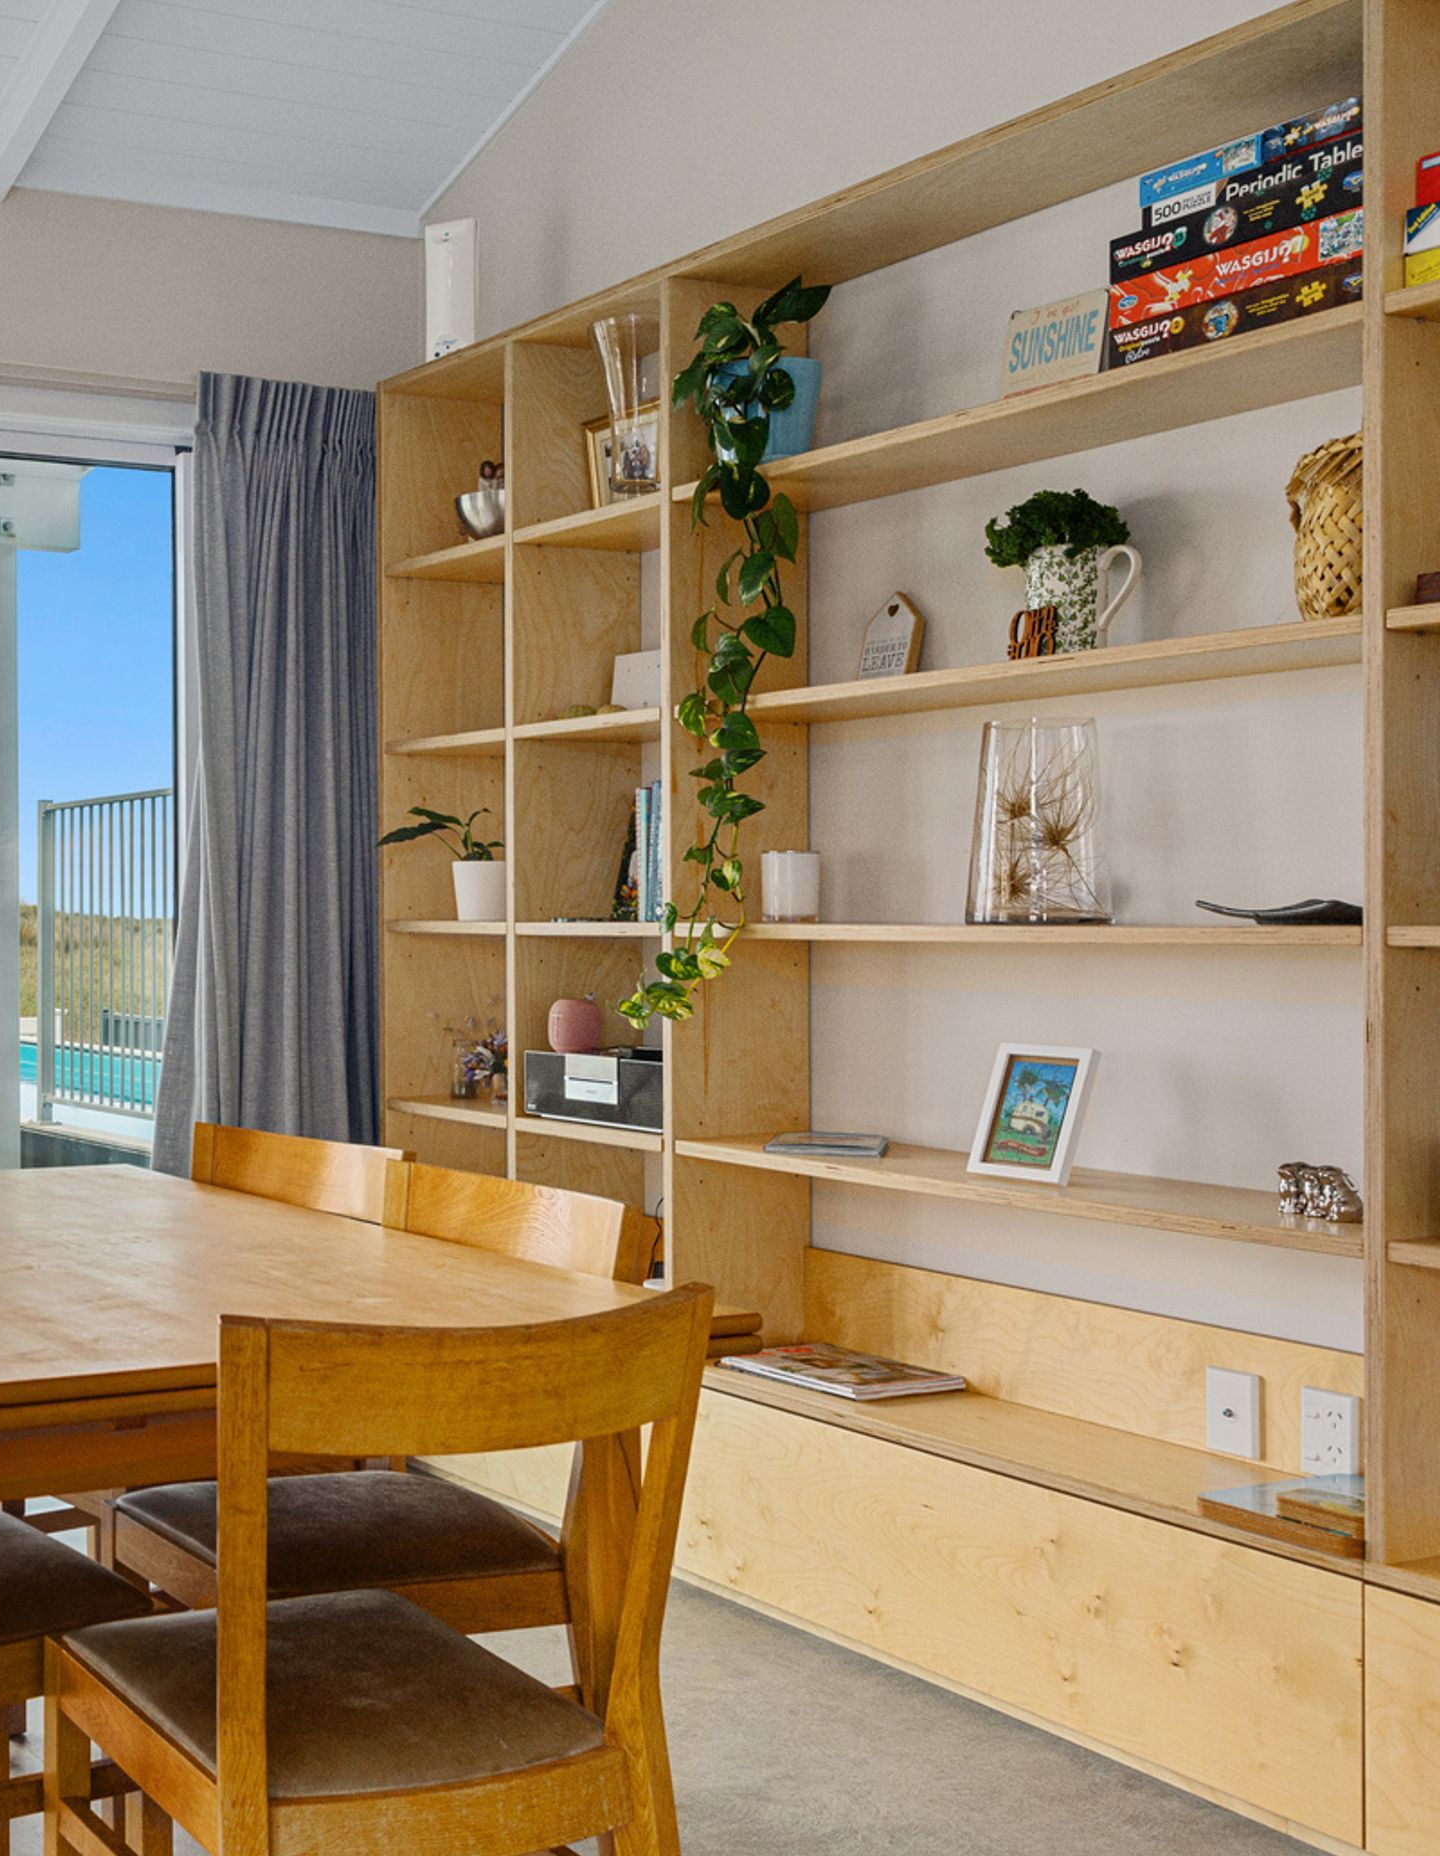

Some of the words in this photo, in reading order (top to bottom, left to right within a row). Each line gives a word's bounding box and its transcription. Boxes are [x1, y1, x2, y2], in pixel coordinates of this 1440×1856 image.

[1225, 164, 1303, 201] Periodic
[1309, 141, 1363, 171] Table
[1154, 201, 1181, 222] 500
[1215, 240, 1292, 276] WASGIJ?
[1009, 309, 1099, 373] SUNSHINE
[862, 652, 905, 672] LEAVE
